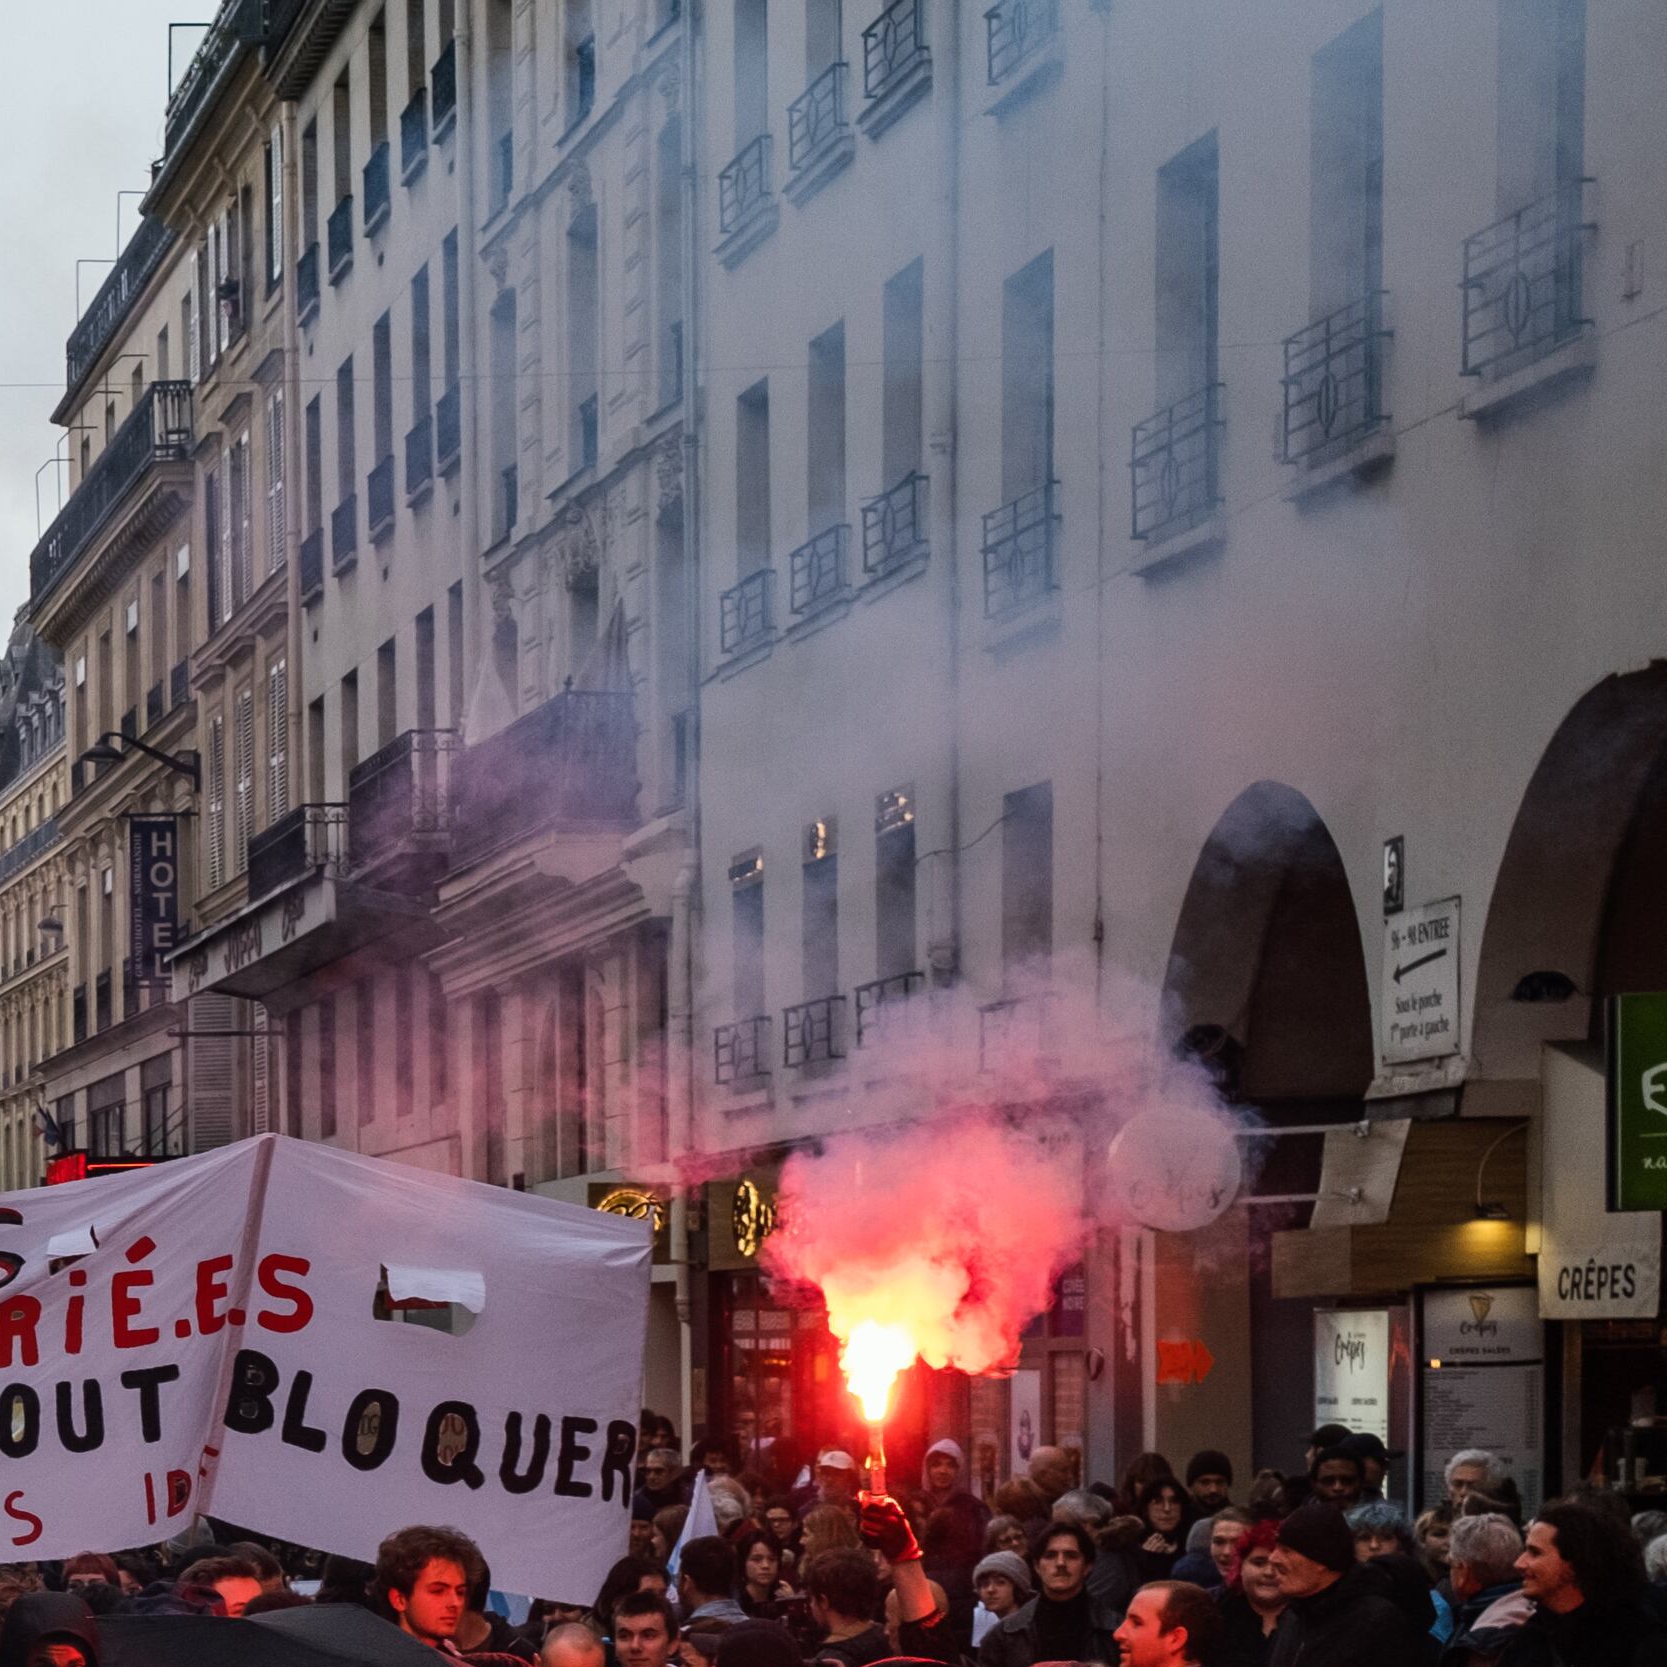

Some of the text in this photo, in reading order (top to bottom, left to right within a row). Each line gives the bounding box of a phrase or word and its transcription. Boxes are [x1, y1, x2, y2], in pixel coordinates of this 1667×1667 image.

[133, 831, 144, 978] GRAND HOTEL NORMANDIE
[150, 831, 174, 978] HOTEL
[1418, 988, 1443, 1016] porche
[1425, 1013, 1451, 1041] gauche
[1557, 1257, 1637, 1302] CRÊPES
[225, 1349, 638, 1508] BLOQUER
